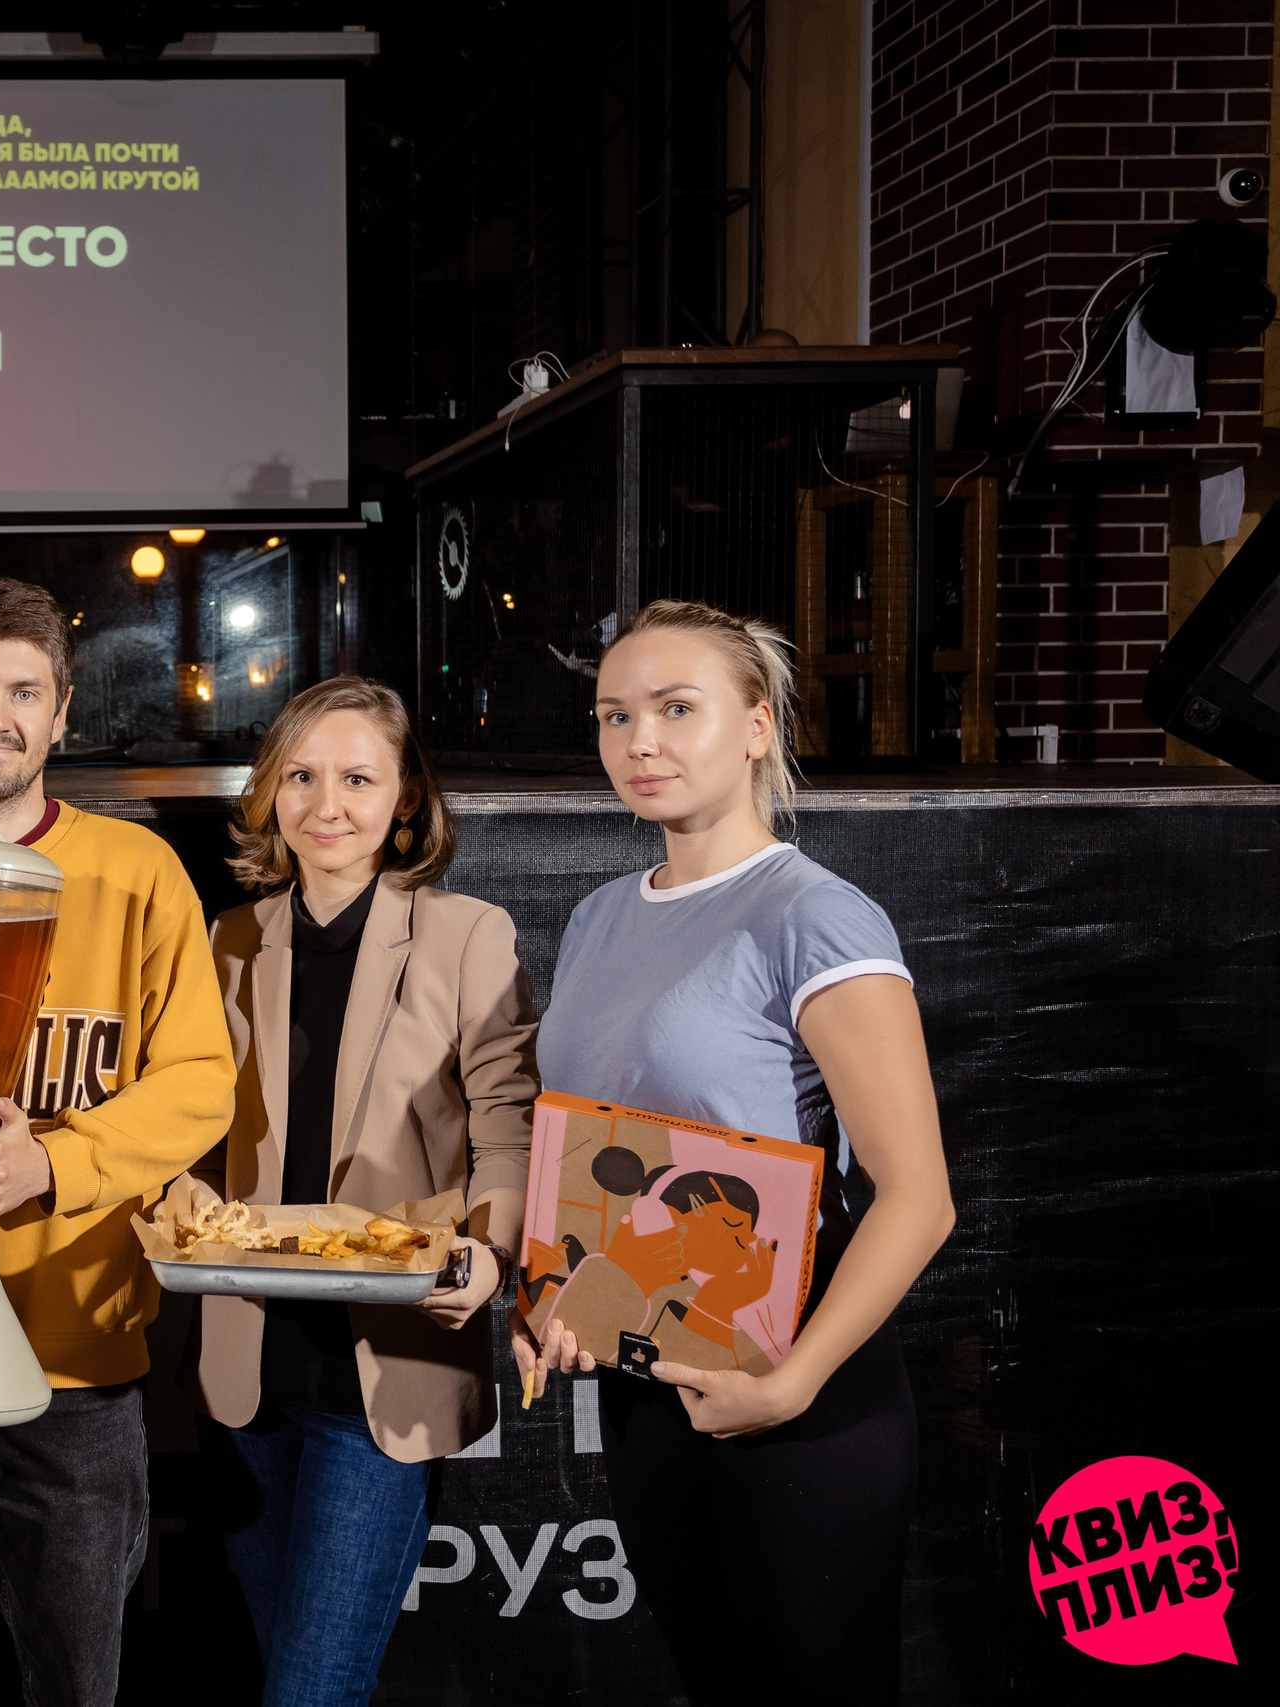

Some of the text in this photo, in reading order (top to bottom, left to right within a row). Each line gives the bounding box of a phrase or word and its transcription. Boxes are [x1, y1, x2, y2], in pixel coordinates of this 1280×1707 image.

[18, 143, 90, 162] БЫЛА
[95, 143, 179, 163] ПОЧТИ
[102, 166, 200, 190] КРУТОЙ
[400, 1520, 637, 1620] РУЗ
